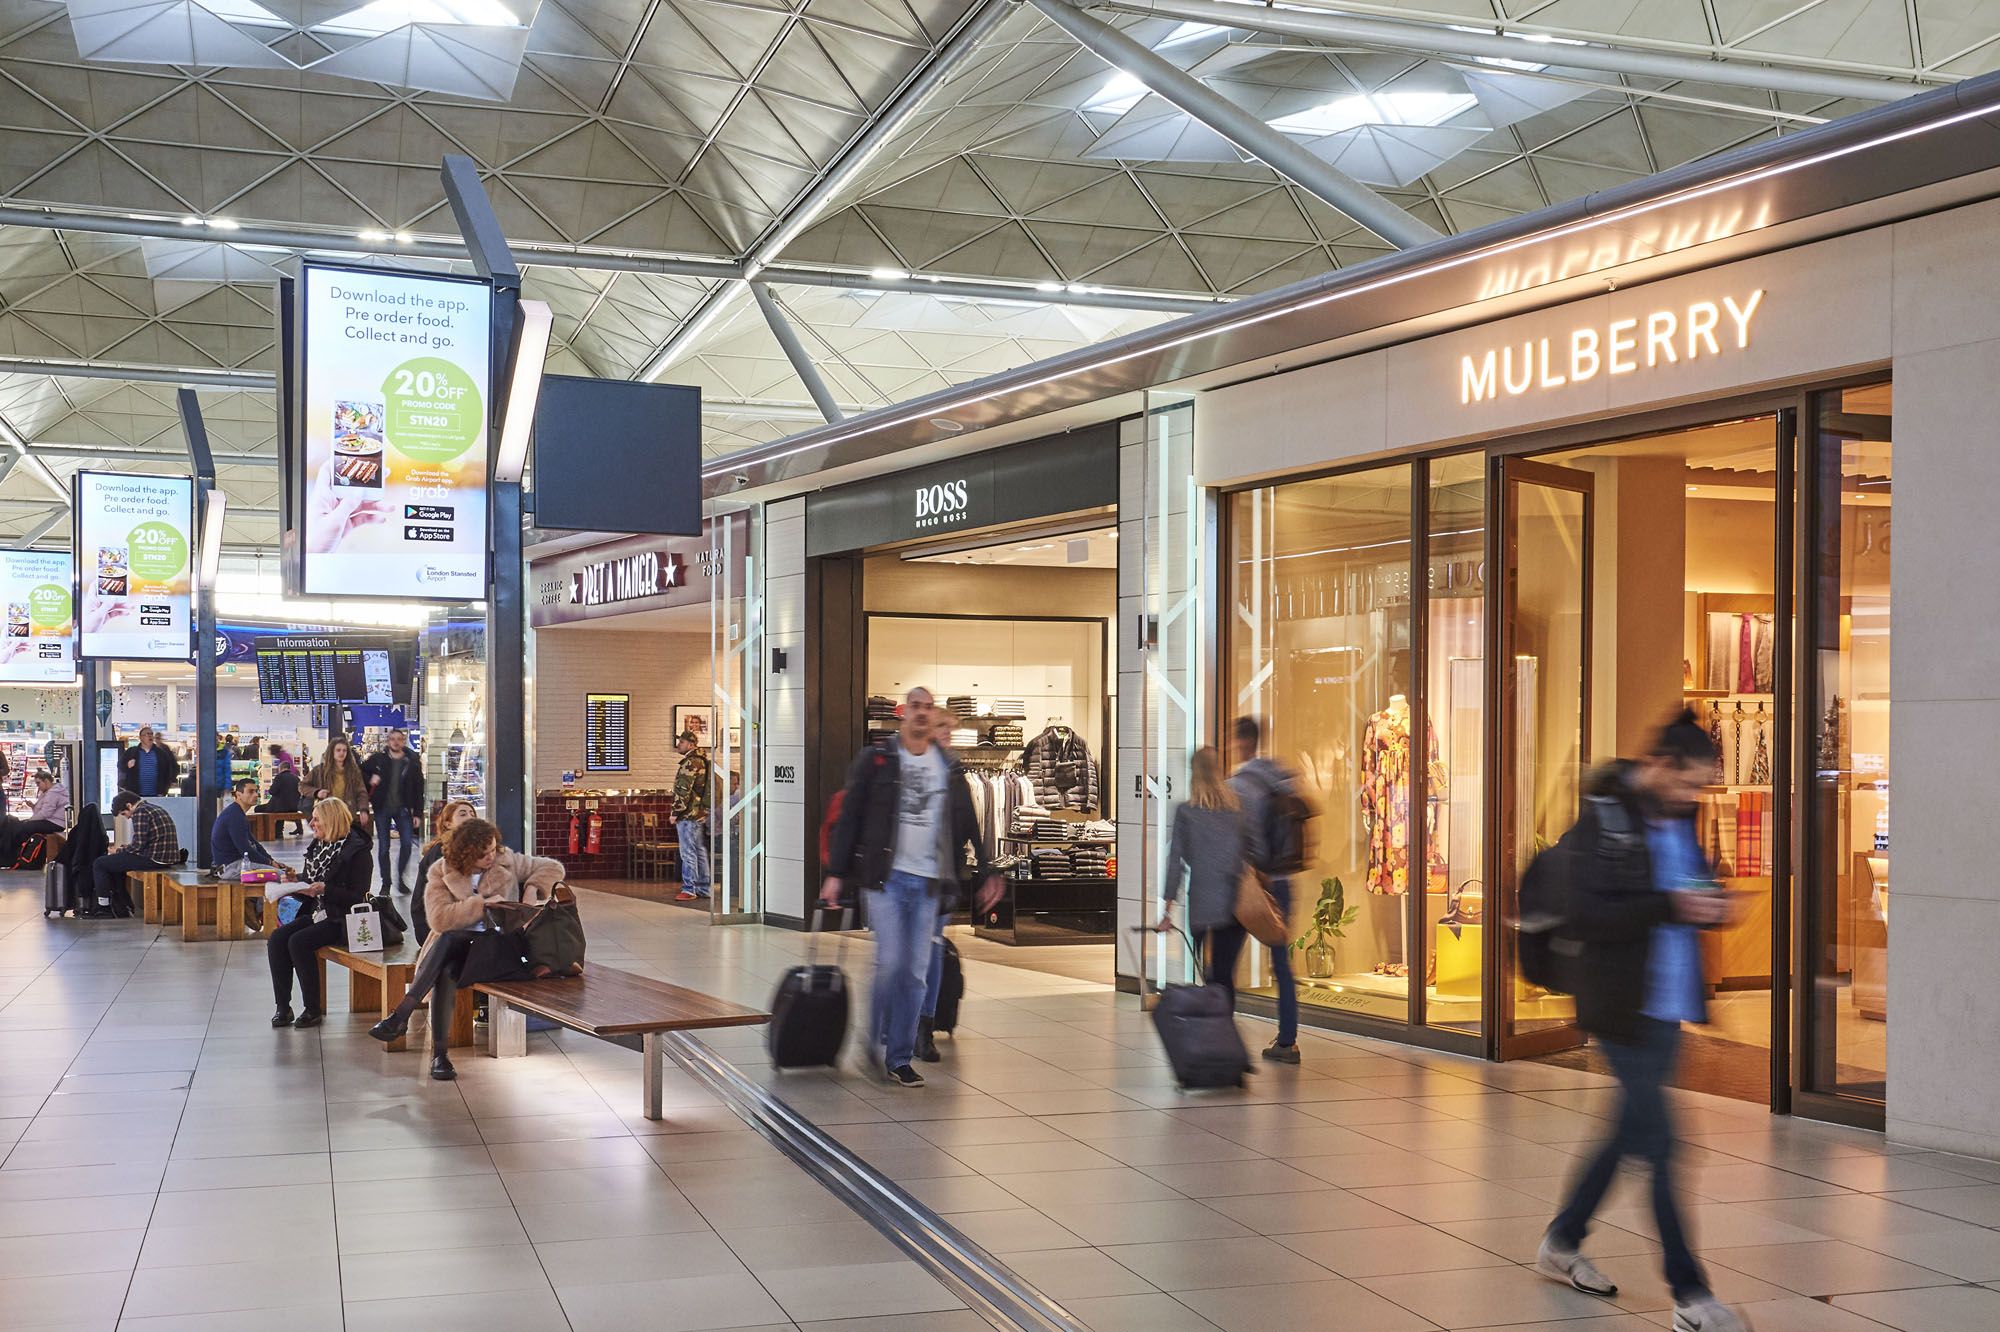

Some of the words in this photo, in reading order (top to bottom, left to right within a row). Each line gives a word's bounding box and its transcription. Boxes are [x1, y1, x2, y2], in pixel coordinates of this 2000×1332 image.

[330, 286, 406, 305] Download
[410, 294, 434, 308] the
[438, 299, 469, 314] app.
[346, 306, 369, 321] Pre
[373, 310, 413, 325] order
[417, 313, 454, 328] food.
[344, 326, 395, 342] Collect
[400, 332, 427, 345] and
[432, 336, 454, 349] go.
[1461, 289, 1766, 404] MULBERRY
[401, 399, 432, 409] PROMO
[433, 402, 457, 410] CODE
[409, 415, 448, 427] STN20
[95, 482, 141, 493] Download
[143, 485, 157, 494] the
[159, 488, 179, 497] app.
[409, 484, 448, 500] grab
[104, 494, 119, 502] Pre
[121, 495, 145, 503] order
[147, 496, 170, 505] food.
[916, 479, 967, 517] BOSS
[103, 505, 135, 514] Collect
[137, 507, 154, 515] and
[419, 511, 439, 519] Google
[440, 511, 452, 520] Play
[916, 517, 939, 528] HUGO
[943, 511, 967, 523] BOSS
[419, 532, 433, 540] App
[433, 532, 451, 540] Store
[582, 562, 604, 606] PRET
[606, 560, 614, 602] A
[616, 551, 659, 600] MANGER
[276, 637, 330, 649] Information
[774, 765, 795, 779] BOSS
[1307, 990, 1371, 1008] MULBERRY
